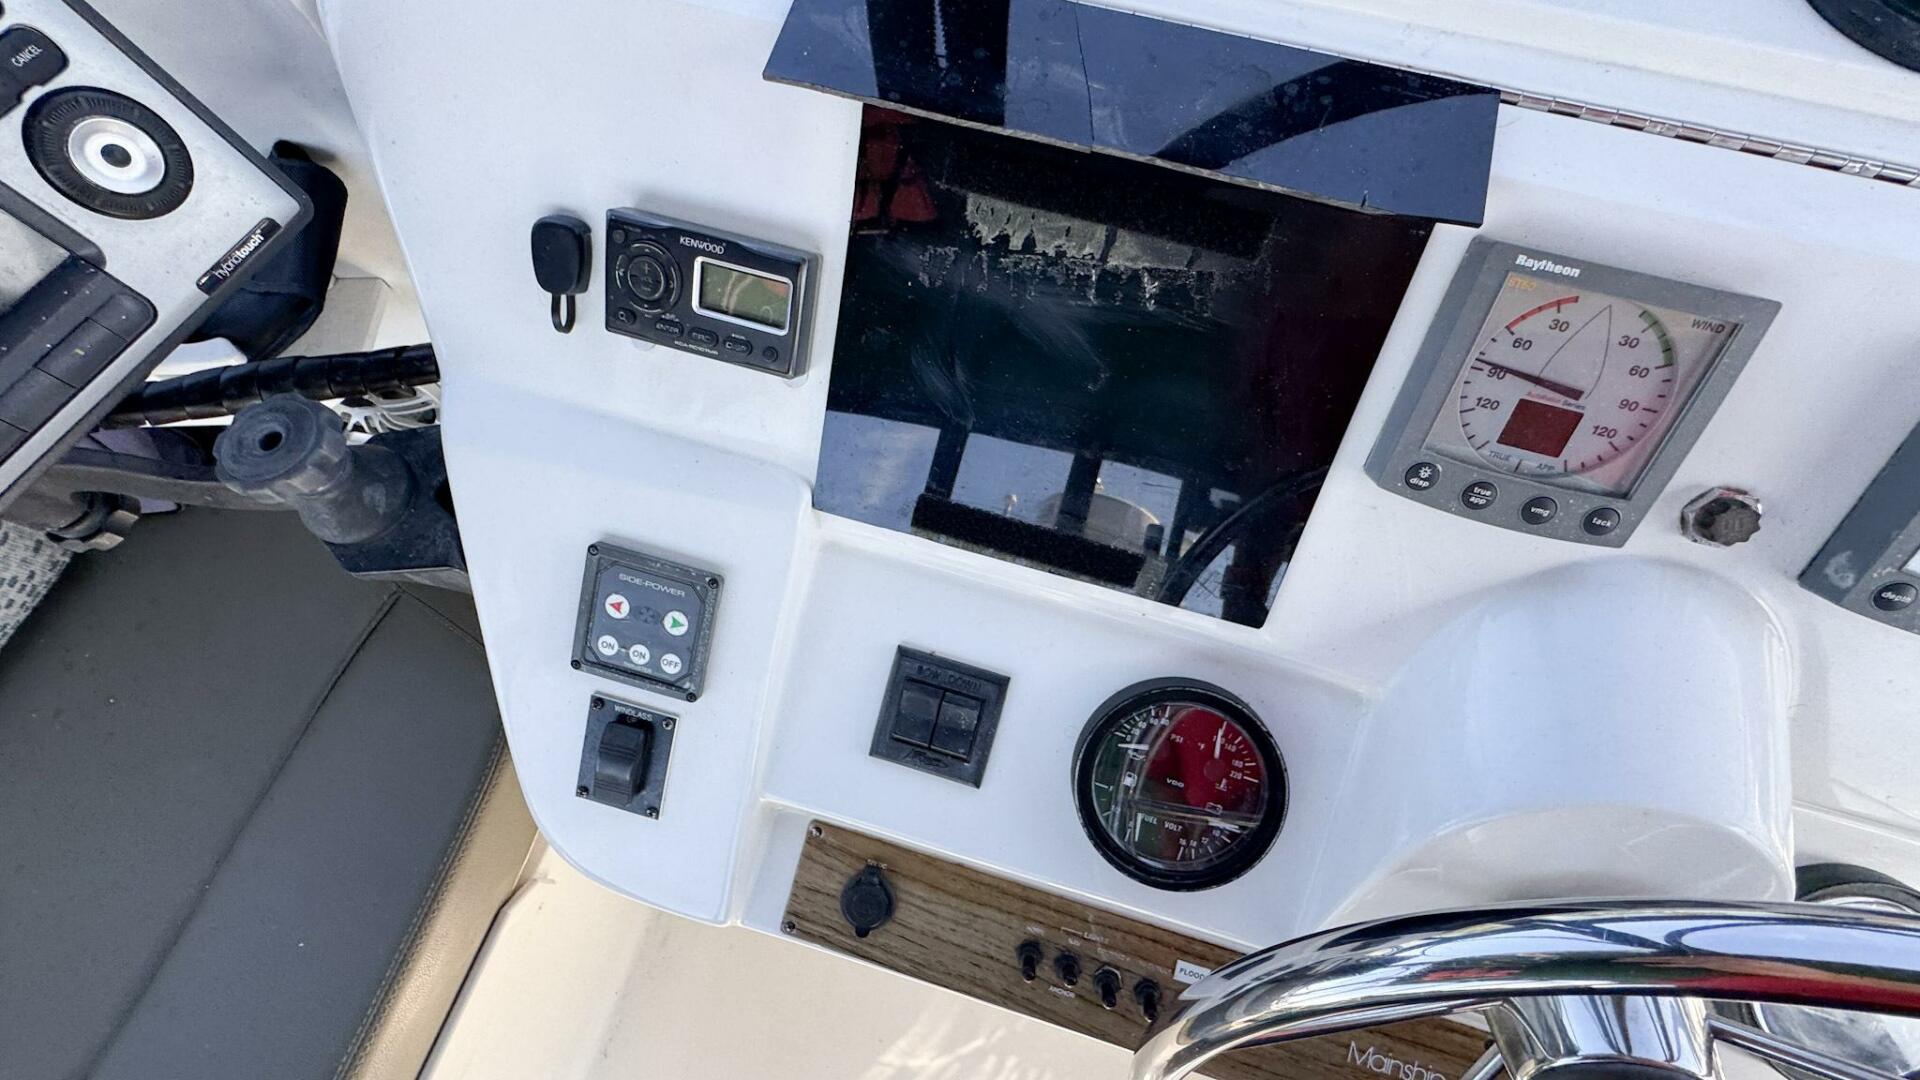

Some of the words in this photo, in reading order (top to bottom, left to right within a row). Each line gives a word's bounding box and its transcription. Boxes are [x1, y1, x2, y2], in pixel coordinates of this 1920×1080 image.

[11, 44, 43, 67] CANCEL
[680, 236, 725, 255] KENWOOD
[1515, 254, 1581, 278] Raytheon
[1548, 318, 1570, 333] 30
[1691, 318, 1726, 334] WIND
[1512, 337, 1533, 351] 60
[1618, 335, 1640, 349] 30
[1487, 366, 1507, 380] 90
[1628, 365, 1650, 378] 60
[1475, 396, 1500, 411] 120
[1618, 399, 1640, 412] 90
[1592, 425, 1618, 439] 120
[1488, 450, 1511, 462] TRUE
[1409, 477, 1430, 488] disp
[1473, 486, 1492, 497] true
[1469, 496, 1487, 505] app
[1530, 506, 1550, 517] vmg
[1591, 517, 1611, 527] tack
[619, 573, 685, 597] SIDE-POWER
[601, 641, 616, 650] ON
[632, 650, 647, 659] ON
[662, 658, 680, 669] OFF
[614, 704, 653, 721] WINDLASS
[1170, 733, 1184, 743] PSI
[1166, 777, 1185, 788] VDO
[1164, 821, 1183, 833] VOLT
